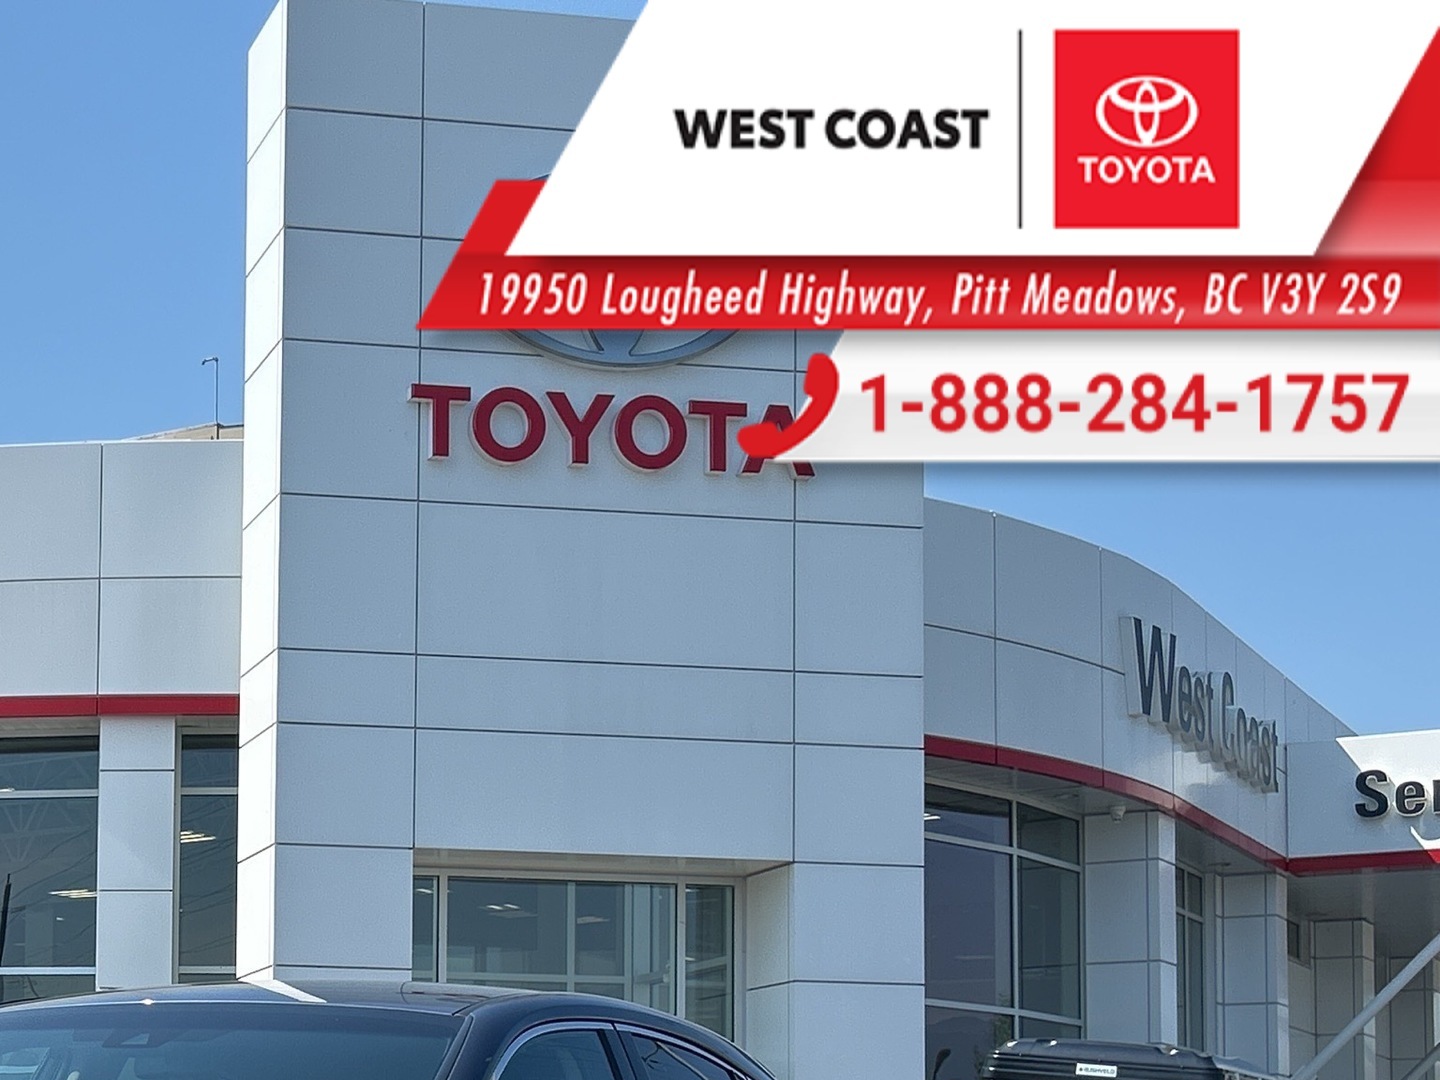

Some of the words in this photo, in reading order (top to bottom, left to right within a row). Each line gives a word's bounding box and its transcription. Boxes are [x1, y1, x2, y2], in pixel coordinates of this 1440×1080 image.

[1130, 616, 1214, 746] West
[1220, 671, 1279, 794] Coast
[1354, 769, 1440, 818] Se
